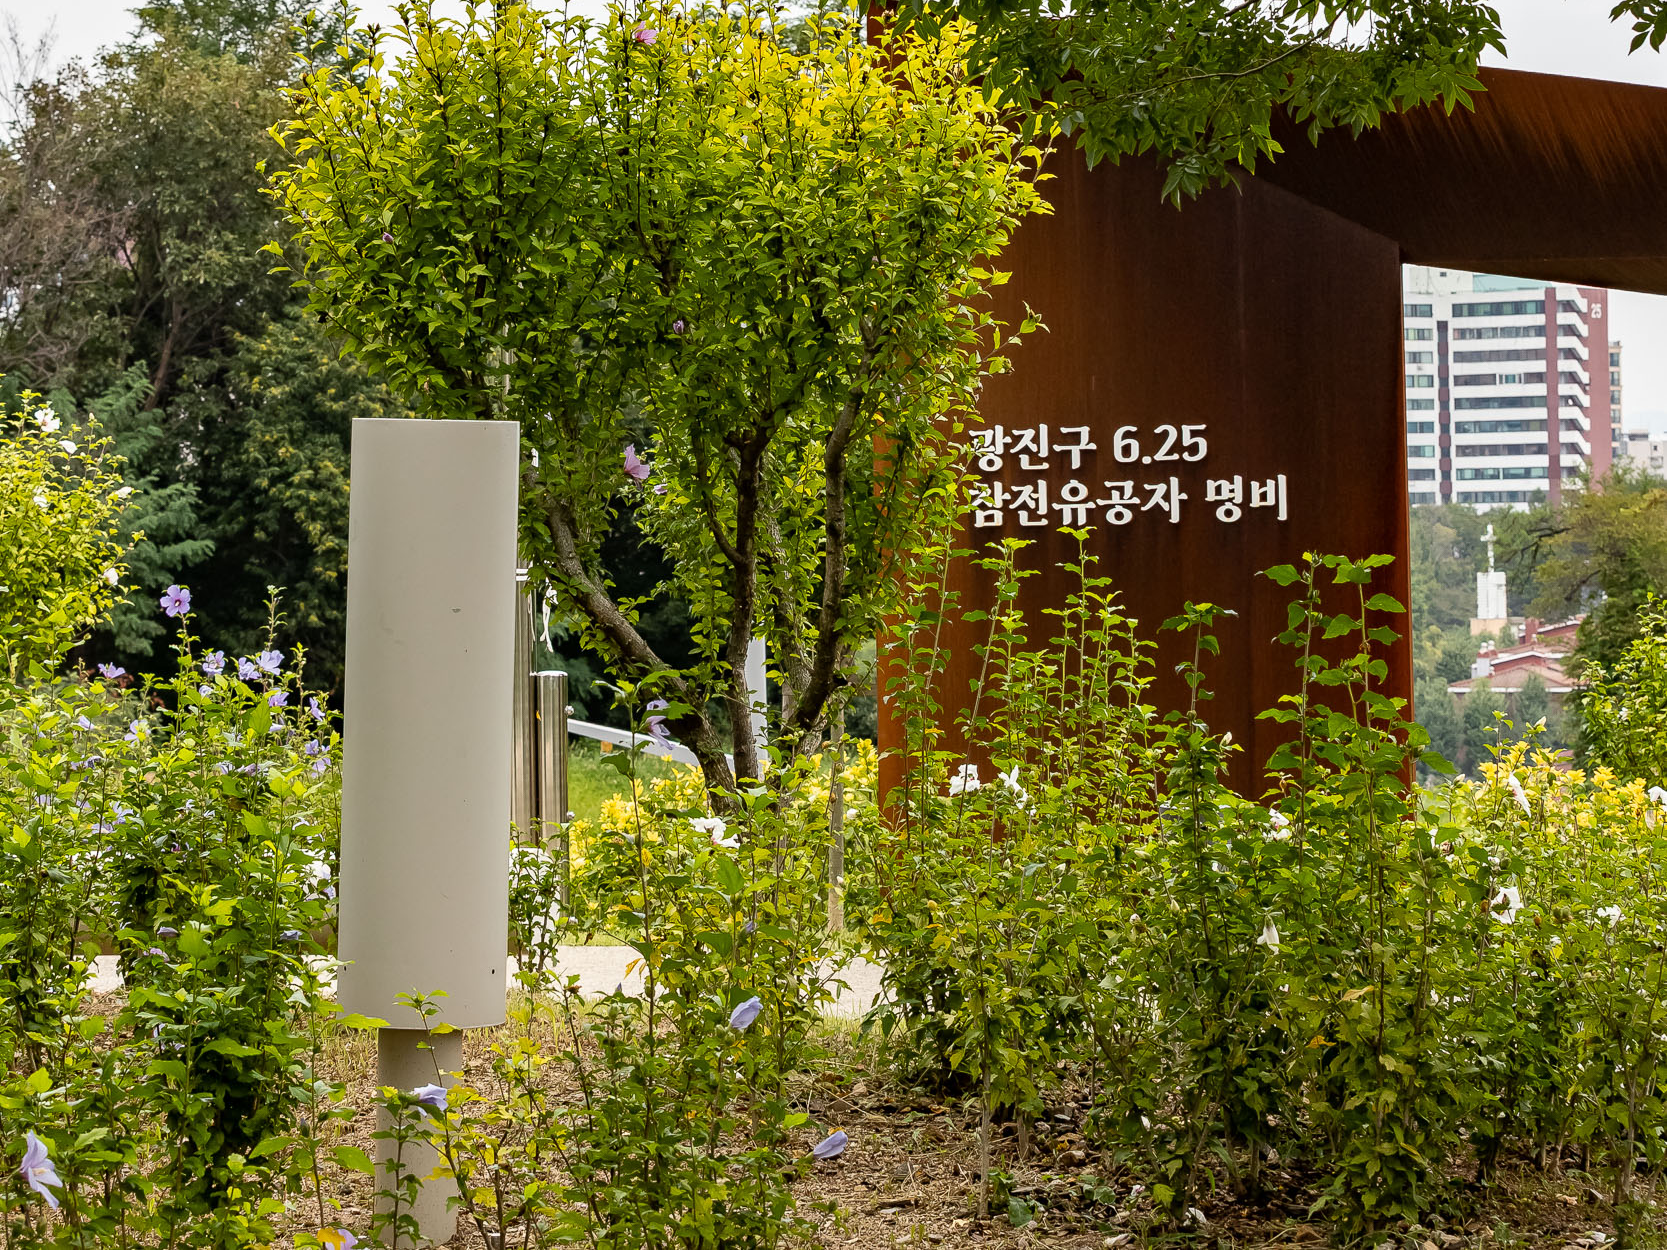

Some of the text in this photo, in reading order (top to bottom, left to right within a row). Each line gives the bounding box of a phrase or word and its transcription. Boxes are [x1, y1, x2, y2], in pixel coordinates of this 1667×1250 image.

[968, 423, 1208, 472] 광진구 6.25
[968, 474, 1287, 528] 참전유공자 명비
